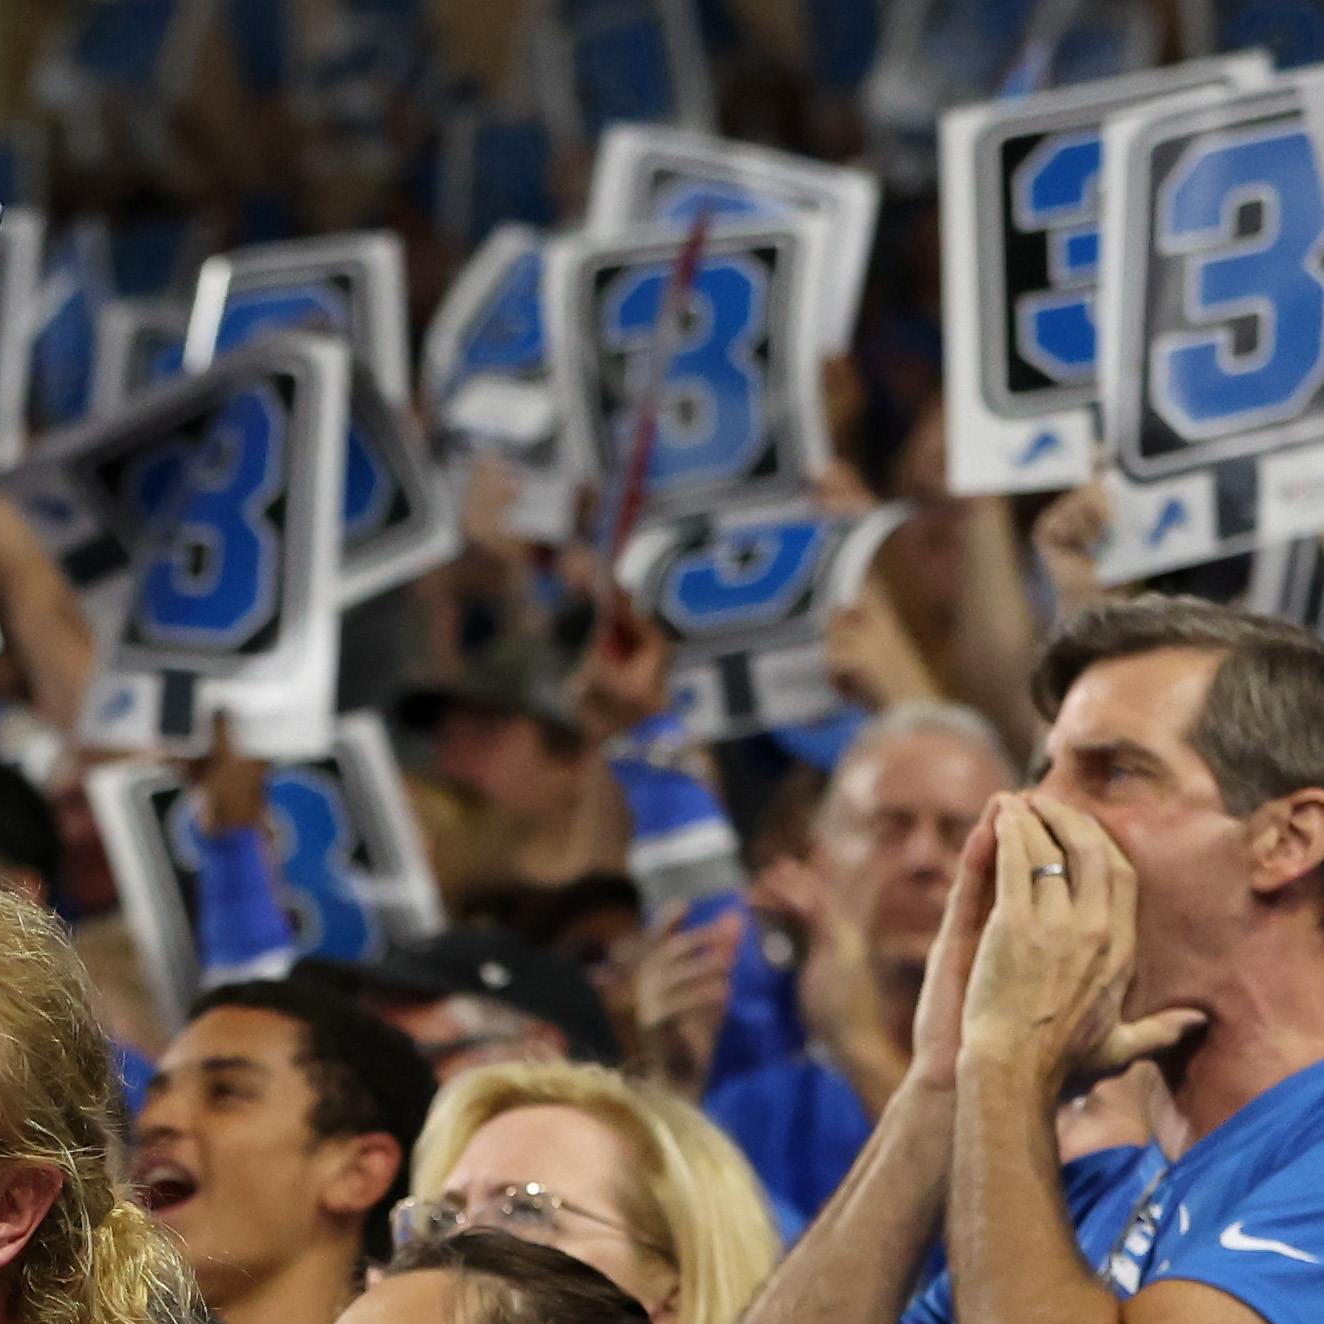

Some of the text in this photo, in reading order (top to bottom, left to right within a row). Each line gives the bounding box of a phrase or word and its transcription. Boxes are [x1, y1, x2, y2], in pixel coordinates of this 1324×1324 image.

[602, 253, 772, 495] 3
[1152, 115, 1324, 442] 3
[128, 380, 284, 648] 3
